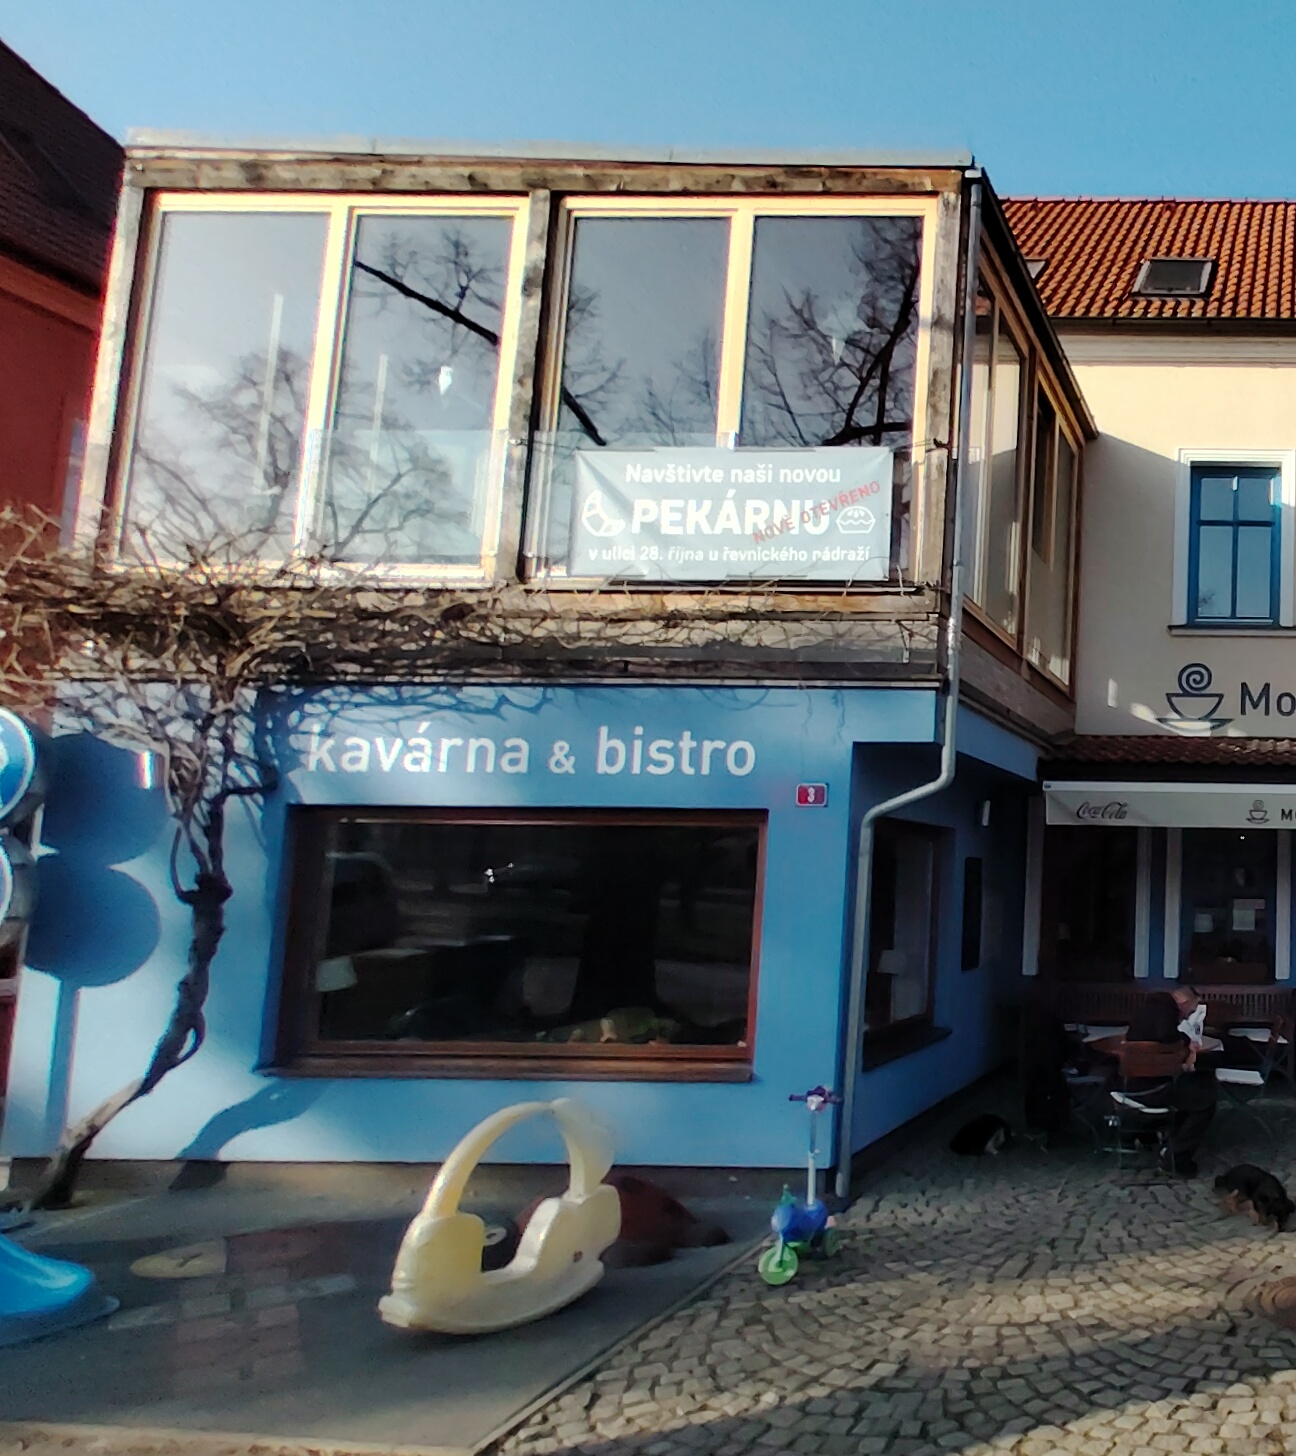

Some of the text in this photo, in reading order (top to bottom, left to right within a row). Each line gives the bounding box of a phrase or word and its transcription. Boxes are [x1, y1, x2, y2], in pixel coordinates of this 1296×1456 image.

[625, 463, 841, 483] Navštivte naši novou
[631, 488, 830, 535] PEKÁRNU
[752, 480, 881, 544] NOVĚ OTEVŘENO
[588, 546, 870, 564] v ulici 28. října u řevnického nádraží
[307, 722, 757, 777] kavárna & bistro
